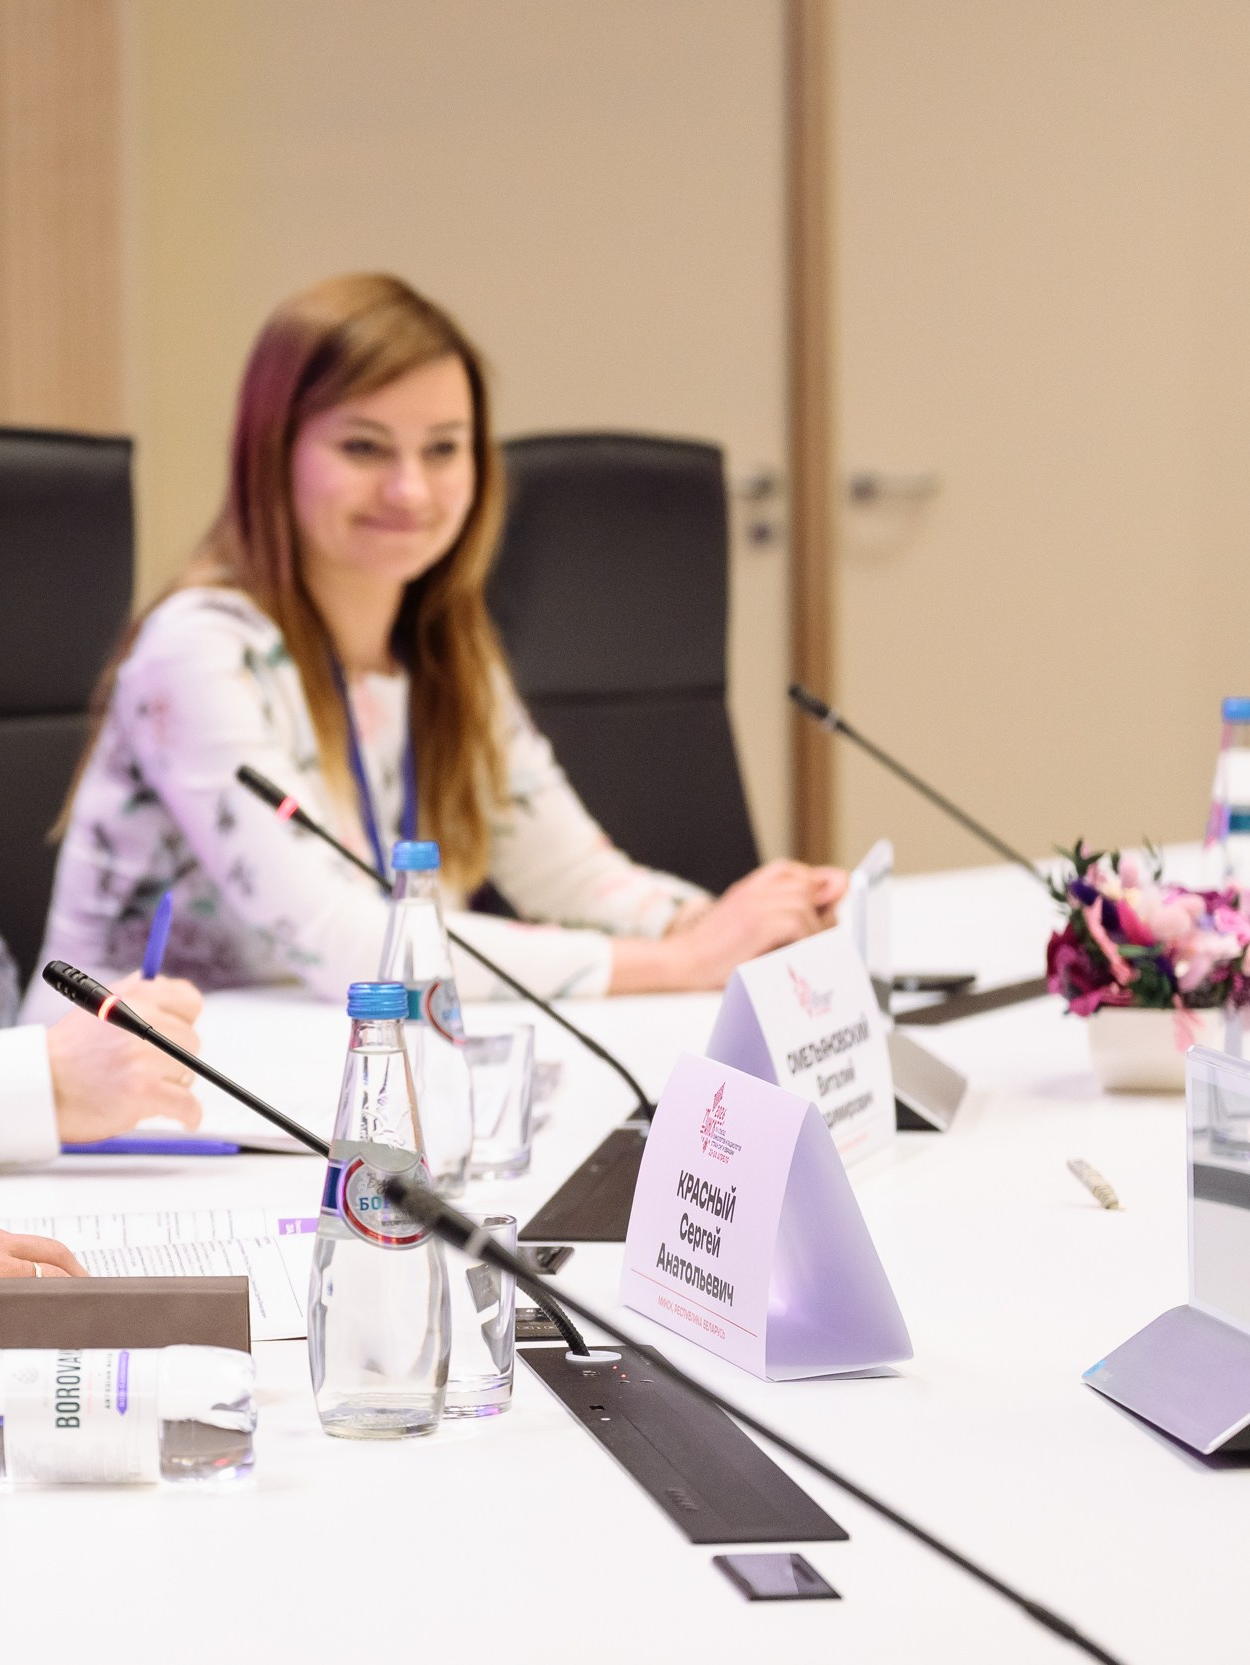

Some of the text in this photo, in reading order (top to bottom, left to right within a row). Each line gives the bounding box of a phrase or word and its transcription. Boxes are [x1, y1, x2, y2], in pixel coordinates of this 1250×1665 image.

[677, 1169, 737, 1223] КРАСНЫЙ
[679, 1212, 721, 1258] Сергей
[656, 1242, 734, 1307] Анатольевич
